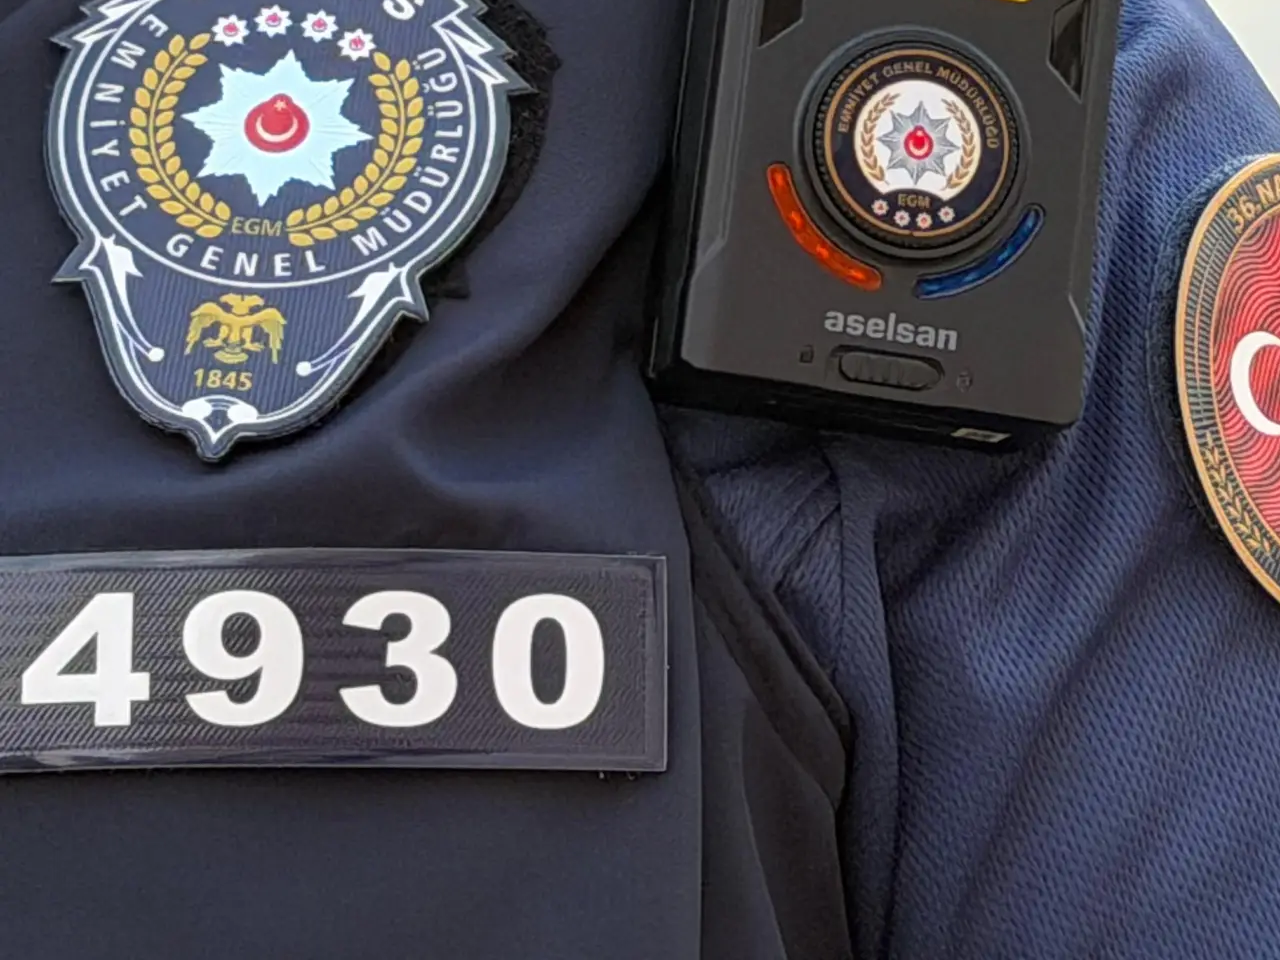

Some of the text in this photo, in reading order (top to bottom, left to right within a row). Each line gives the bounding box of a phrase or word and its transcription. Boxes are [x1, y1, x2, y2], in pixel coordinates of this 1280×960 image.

[882, 61, 934, 78] GENEL
[89, 13, 169, 219] EMNİYET
[165, 232, 326, 278] GENEL
[898, 193, 931, 209] EGM
[231, 216, 283, 237] EGM
[823, 310, 959, 351] aselsan
[193, 368, 253, 392] 1845
[20, 589, 606, 730] 4930
